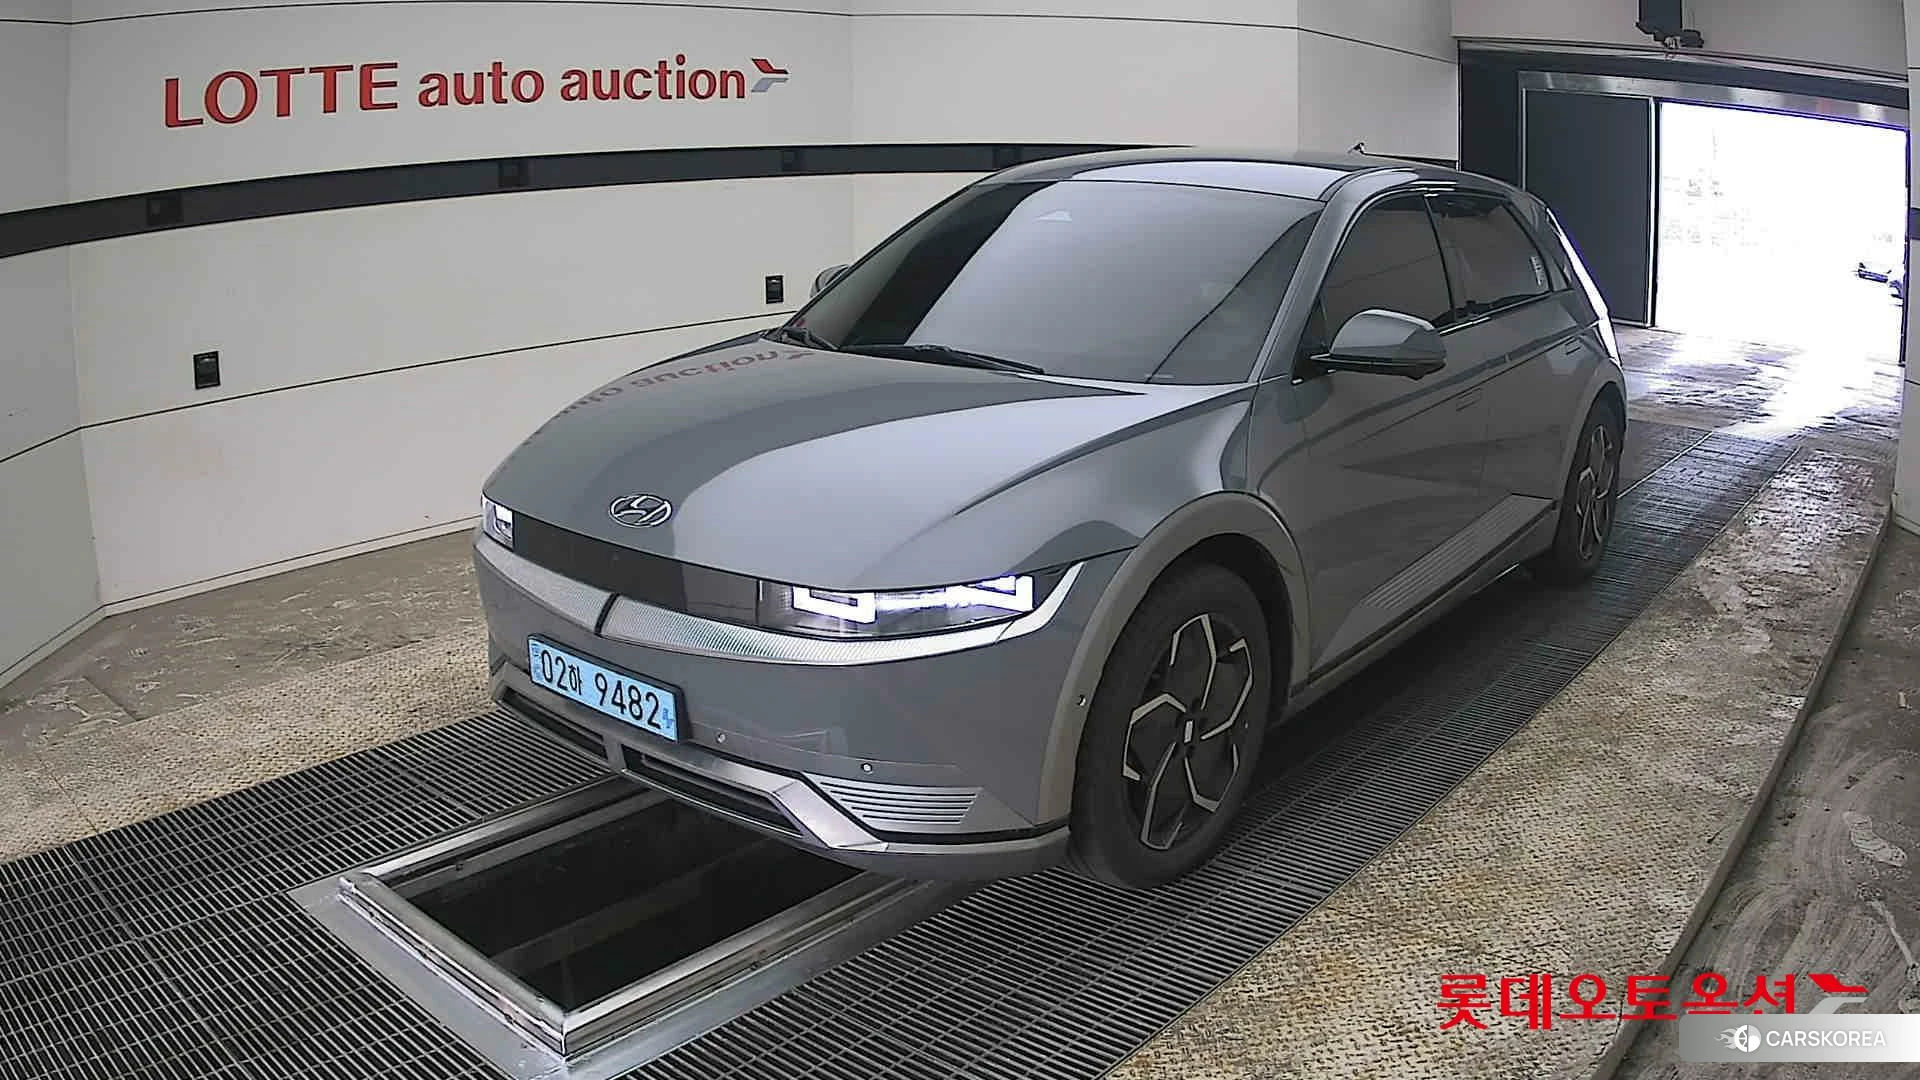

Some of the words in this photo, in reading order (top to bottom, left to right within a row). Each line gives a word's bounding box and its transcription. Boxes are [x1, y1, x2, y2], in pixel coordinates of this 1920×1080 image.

[164, 61, 400, 128] LOTTE
[417, 61, 546, 108] auto
[559, 54, 747, 102] auction
[541, 649, 583, 696] 02하
[594, 672, 662, 730] 9482
